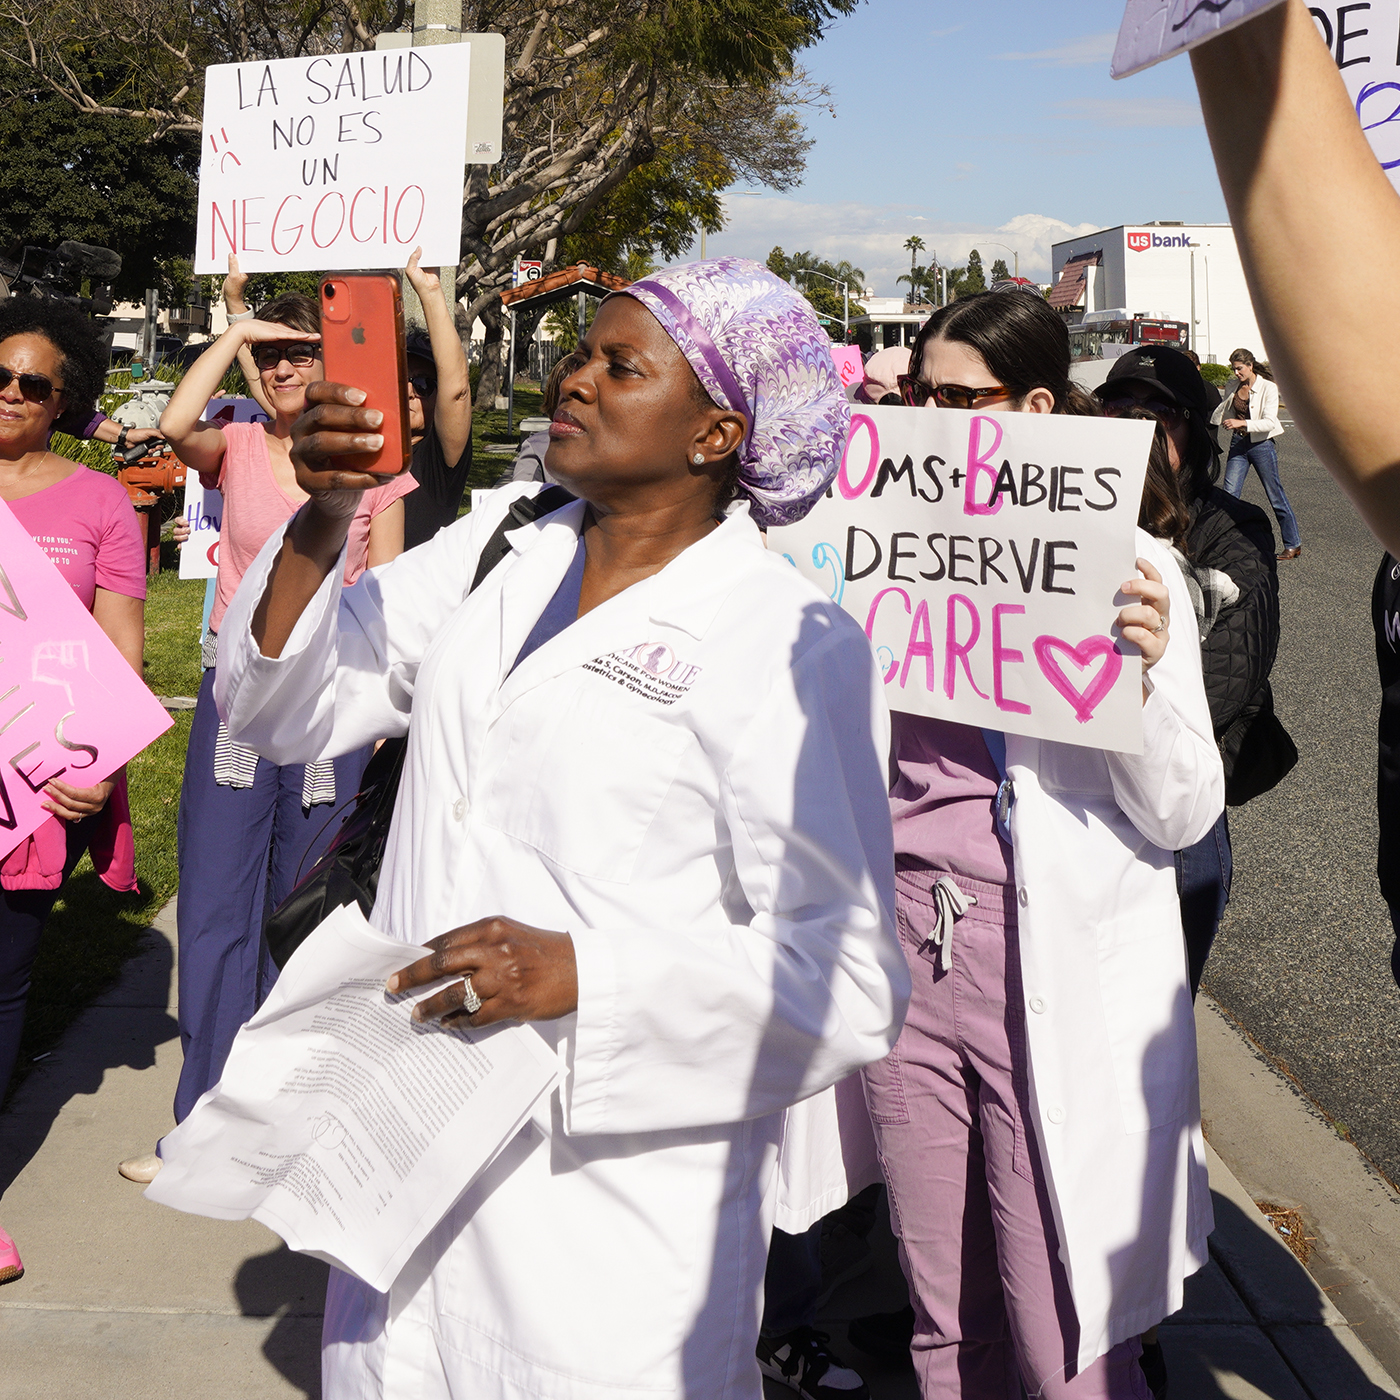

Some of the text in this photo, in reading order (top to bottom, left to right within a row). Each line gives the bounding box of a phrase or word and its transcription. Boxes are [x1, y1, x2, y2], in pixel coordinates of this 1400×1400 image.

[237, 51, 433, 110] LA SALUD
[273, 111, 383, 150] NO ES
[302, 153, 339, 186] UN
[212, 185, 426, 261] NEGOCIO
[1152, 232, 1191, 248] bank
[825, 413, 1122, 517] OMS+BABIES
[844, 526, 1078, 596] DESERVE
[864, 586, 1032, 715] CARE
[613, 665, 643, 687] Carson,
[618, 678, 626, 686] &
[626, 682, 677, 706] Gynecology
[658, 678, 690, 692] WOMEN
